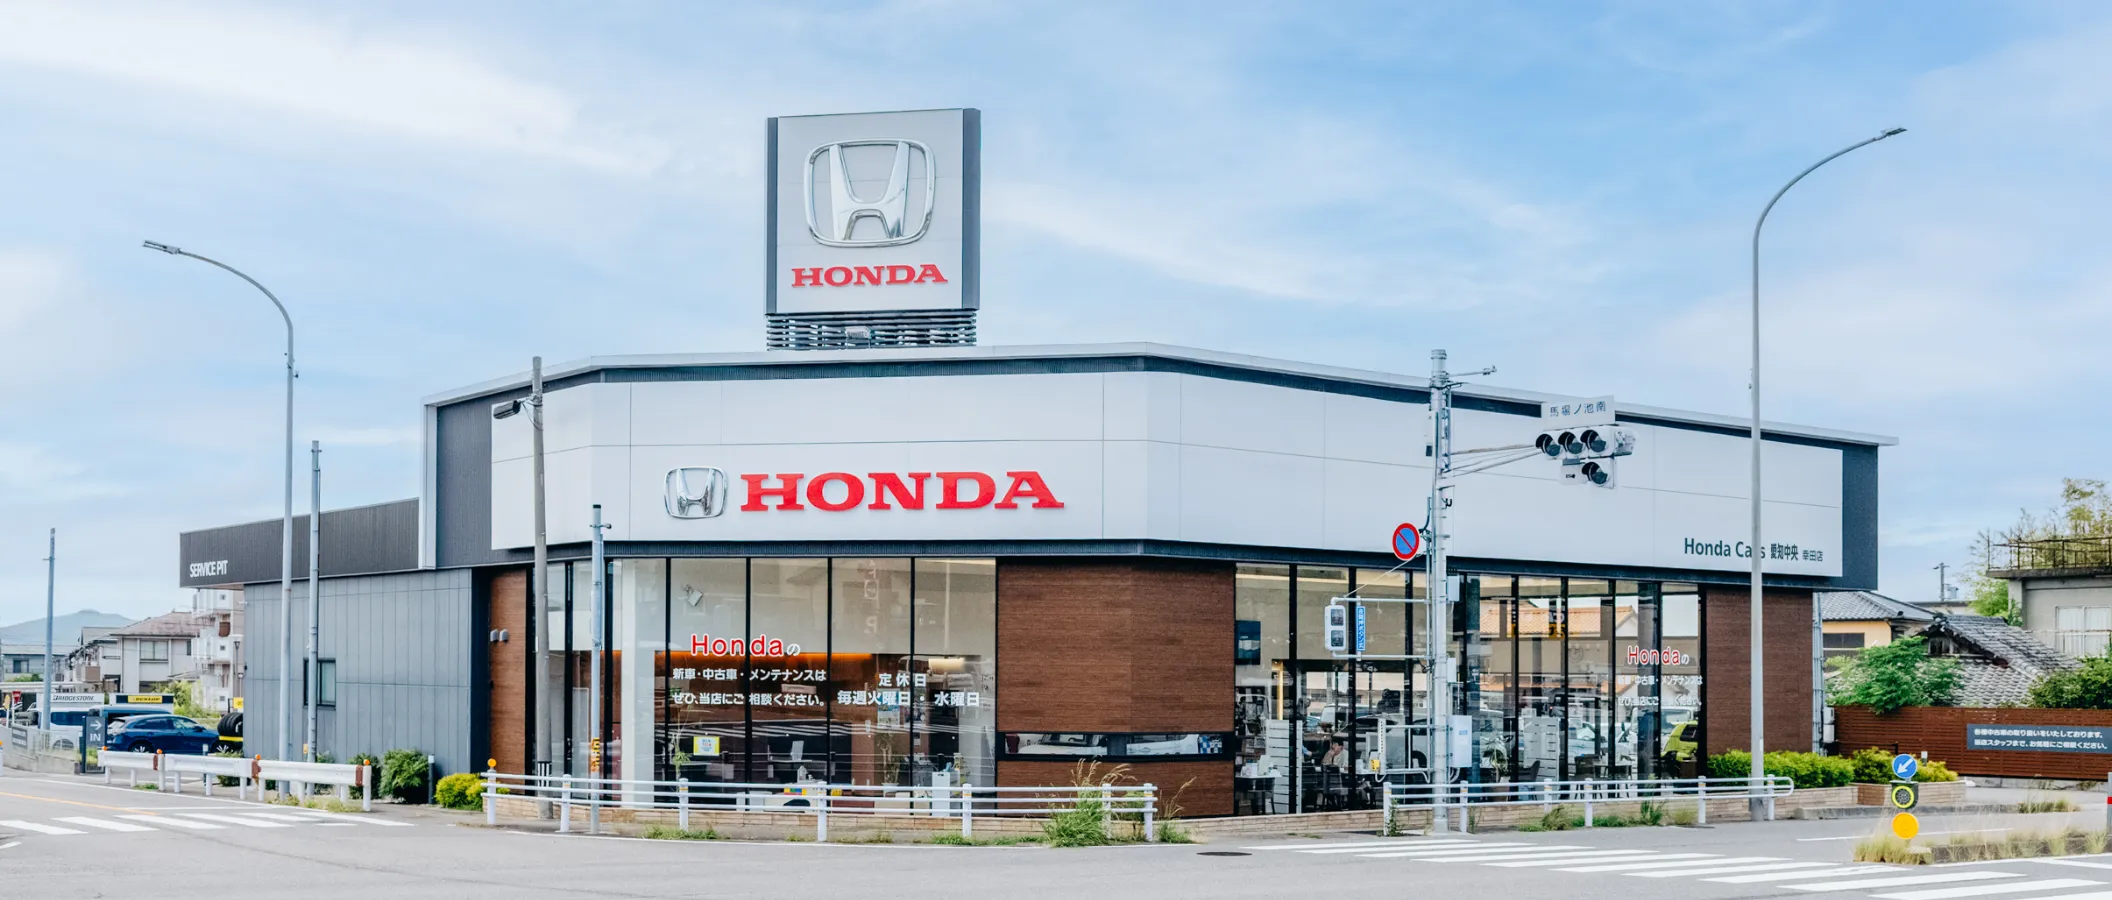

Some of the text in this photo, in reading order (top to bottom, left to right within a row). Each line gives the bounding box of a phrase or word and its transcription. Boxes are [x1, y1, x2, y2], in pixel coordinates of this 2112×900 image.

[791, 264, 948, 287] HONDA
[740, 471, 1065, 512] HONDA
[1684, 537, 1823, 562] Honda Cas 愛知中央 幸田店
[190, 560, 228, 578] SERVICE PIT
[878, 673, 927, 687] 定休日
[90, 734, 101, 742] IN
